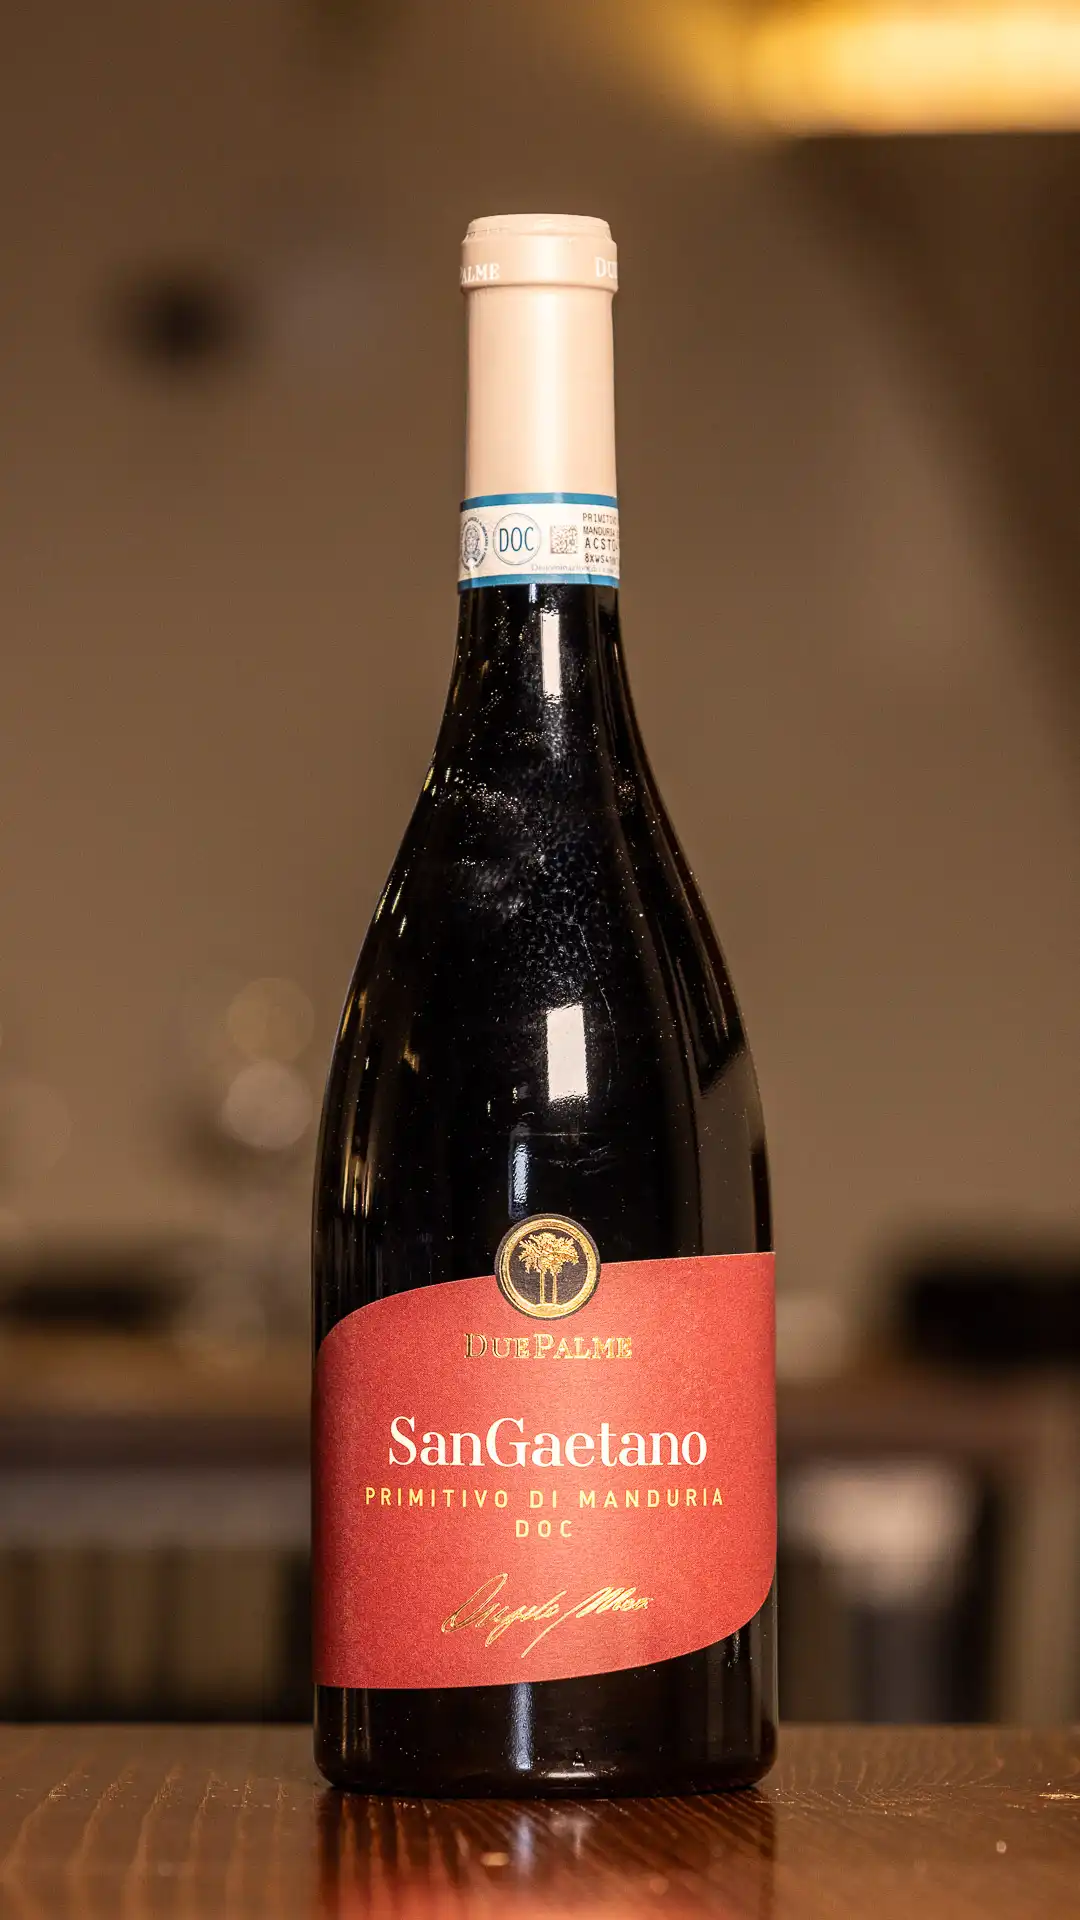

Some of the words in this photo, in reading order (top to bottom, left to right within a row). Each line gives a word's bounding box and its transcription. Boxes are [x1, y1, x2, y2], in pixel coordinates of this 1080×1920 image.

[500, 527, 534, 552] DOC
[388, 1415, 708, 1468] SanGaetano
[365, 1486, 509, 1509] PRIMITIVO
[529, 1490, 558, 1509] DI
[579, 1487, 724, 1509] MANDURIA
[515, 1519, 573, 1538] DOC
